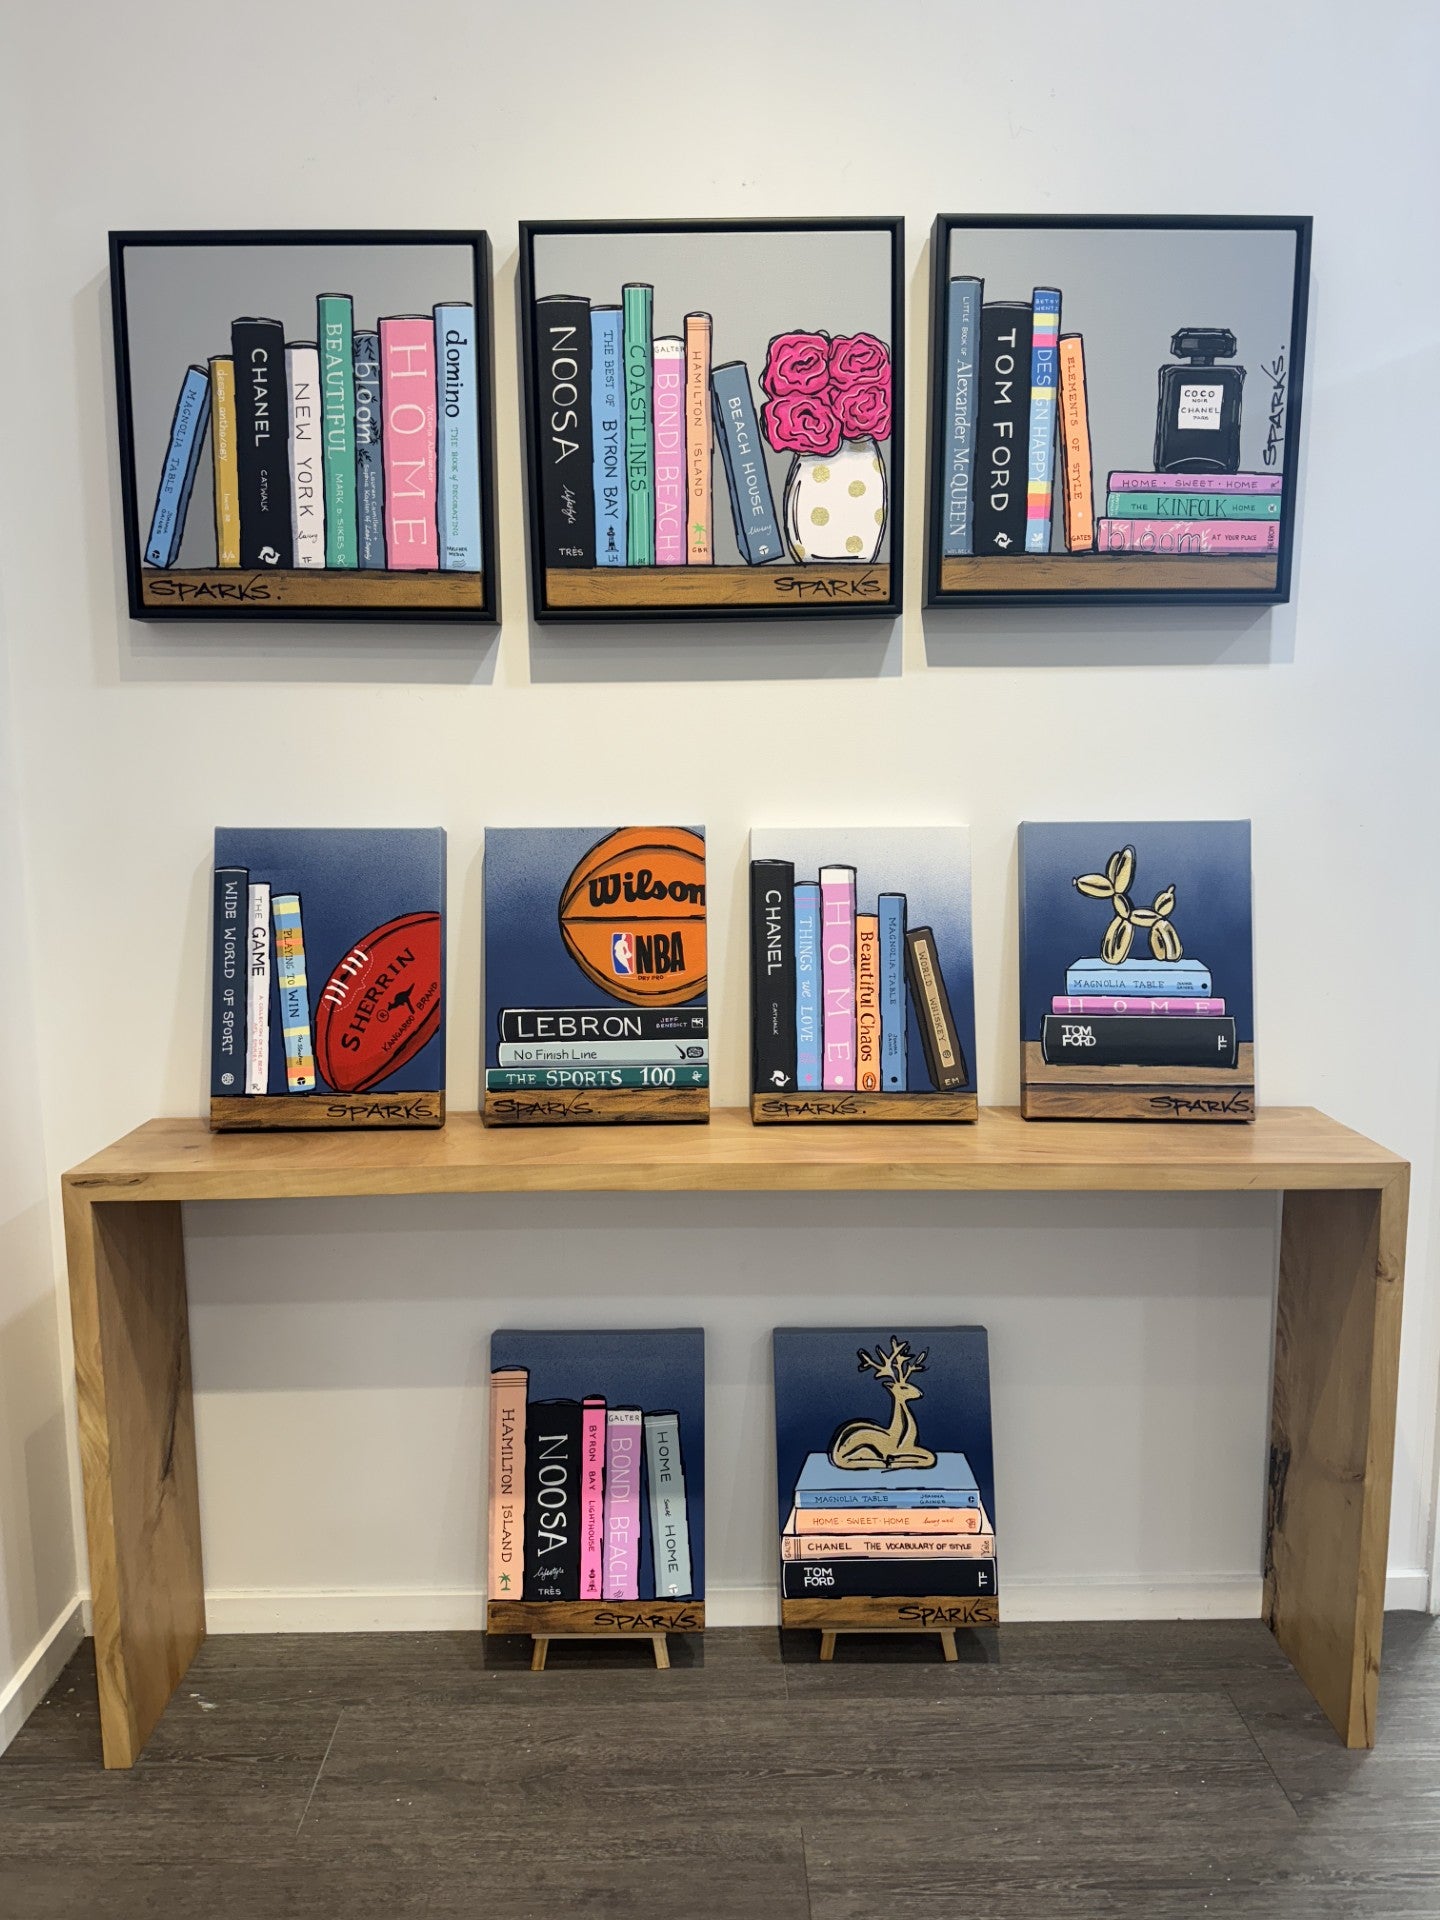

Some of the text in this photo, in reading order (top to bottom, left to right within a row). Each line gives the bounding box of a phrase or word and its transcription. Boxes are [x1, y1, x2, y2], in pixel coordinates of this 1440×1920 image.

[962, 296, 970, 322] LITTLE
[354, 361, 379, 444] bloom
[444, 330, 467, 418] domino
[549, 326, 579, 464] NOOSA
[954, 358, 973, 443] Alexander
[1184, 390, 1215, 398] COCO
[165, 389, 197, 494] MAGNOLIA TABLE
[251, 348, 270, 512] CHANEL CATWALK
[294, 383, 313, 517] NEW YORK
[326, 323, 346, 550] BEAUTIFUL MARK SIKES
[388, 342, 428, 545] HOME
[450, 427, 459, 447] THE
[602, 330, 619, 519] THE BEST OF BYRON BAY
[630, 344, 647, 492] COASTLINES
[657, 373, 680, 549] BONDI BEACH
[692, 351, 703, 497] HAMILTON ISLAND
[728, 397, 764, 517] BEACH HOUSE
[990, 328, 1016, 511] TOM FORD
[1031, 426, 1047, 482] HAPPY
[1067, 356, 1083, 500] ELEMENTS OF STYLE
[451, 484, 460, 536] DECORATING
[1122, 479, 1258, 489] HOME SWEET HOME
[1131, 503, 1148, 511] THE
[1156, 497, 1228, 518] KINFOLK
[1108, 520, 1257, 553] bloom AT YOUR PLACE
[589, 869, 706, 907] Wilson
[221, 881, 238, 1055] WIDE WORLD OF SPORT
[251, 896, 266, 977] THE GAME
[283, 928, 300, 1018] PLAYING TO WIN
[635, 931, 686, 974] NBA
[765, 889, 782, 1035] CHANEL CATWALK
[799, 916, 814, 1043] THINGS we LOVE
[888, 917, 897, 1005] MAGNOLIA TABLE
[341, 947, 416, 1051] SHERRIN
[381, 982, 438, 1052] KANGAROO BRAND
[825, 900, 851, 1063] HOME
[860, 931, 876, 1062] Beautiful Chaos
[918, 949, 946, 1041] WORLD WHISKEY
[1066, 998, 1211, 1015] HOME
[1073, 979, 1165, 989] MAGNOLIA TABLE
[514, 1049, 597, 1060] No Finish Line
[518, 1016, 642, 1037] LEBRON
[1062, 1025, 1092, 1036] TOM
[1062, 1035, 1096, 1047] FORD
[505, 1067, 676, 1087] THE SPORTS 100
[608, 1414, 640, 1422] GALTER
[501, 1408, 515, 1563] HAMILTON ISLAND
[537, 1433, 568, 1557] NOOSA
[588, 1424, 597, 1552] BYRON BAY LIGHTHOUSE
[609, 1437, 633, 1587] BONDI BEACH
[657, 1431, 679, 1573] HOME HOME
[812, 1517, 910, 1525] HOME SWEET HOME
[815, 1495, 858, 1504] MAGNOLIA
[803, 1567, 833, 1577] TOM
[804, 1576, 835, 1587] FORD
[807, 1542, 852, 1551] CHANEL
[864, 1541, 882, 1550] THE
[885, 1542, 934, 1551] VOCABULARY
[936, 1542, 947, 1550] OF
[978, 1571, 988, 1587] TF
